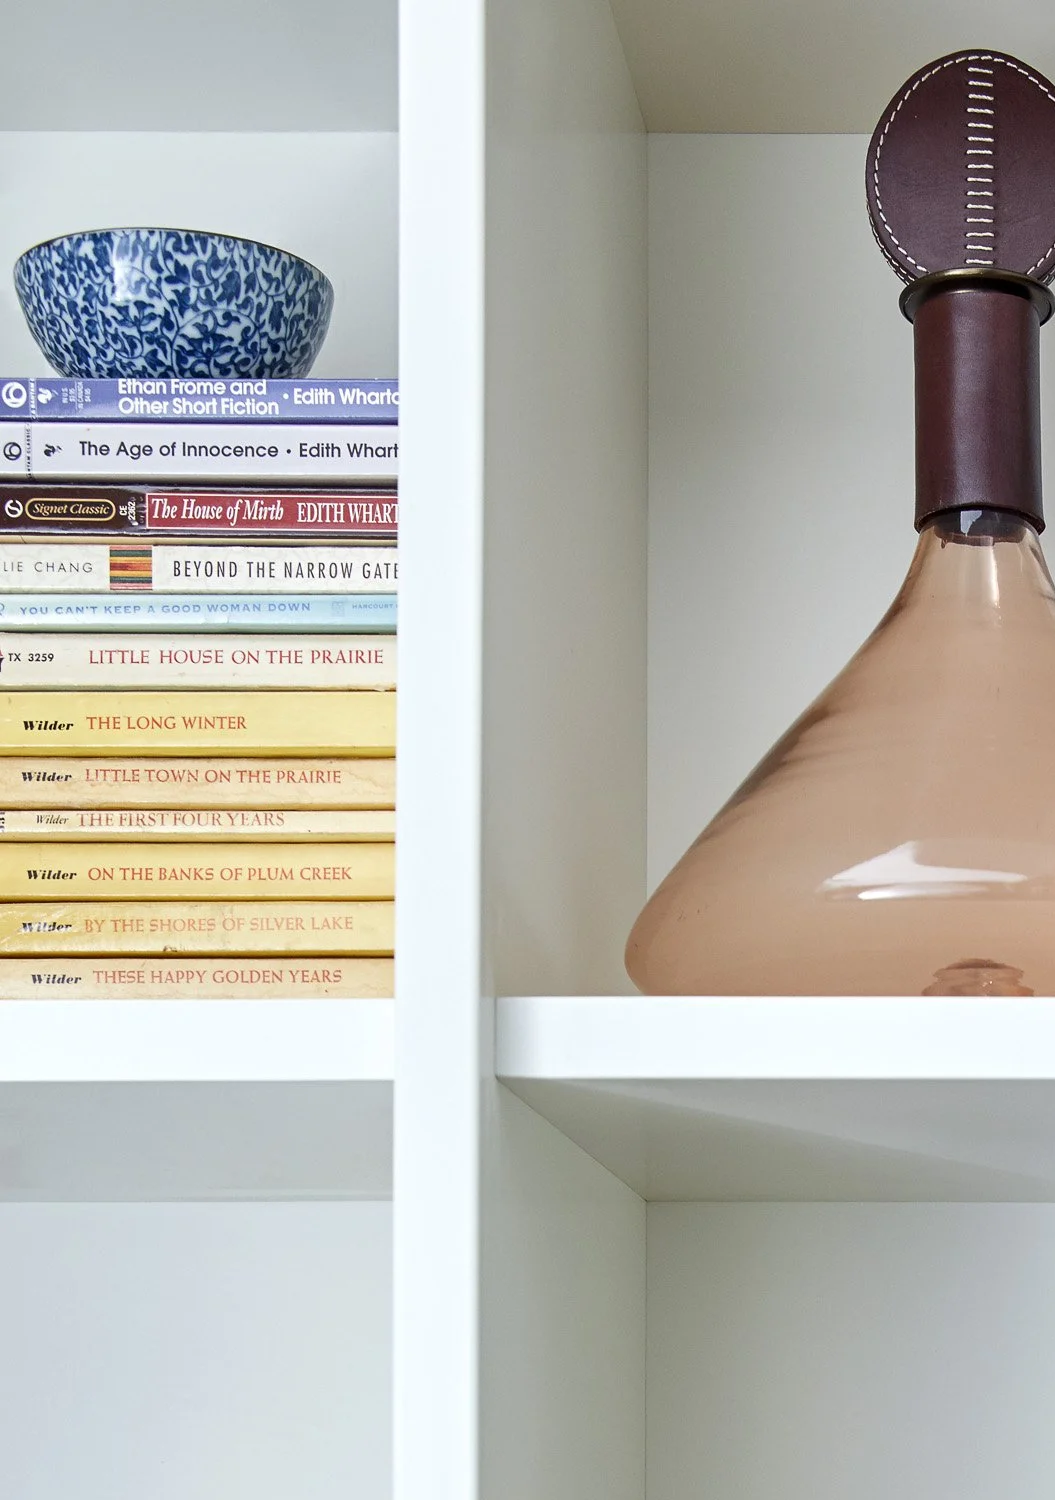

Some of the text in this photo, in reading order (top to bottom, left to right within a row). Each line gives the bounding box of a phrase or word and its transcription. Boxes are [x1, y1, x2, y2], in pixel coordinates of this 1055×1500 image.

[118, 379, 267, 395] Ethan Frome and
[293, 388, 336, 405] Edith
[118, 397, 279, 415] Other Short Fiction
[79, 441, 399, 461] The Age of Innocence Edith Whart
[32, 503, 110, 516] Signet Classic
[119, 505, 128, 516] CE
[127, 501, 136, 520] 2362
[151, 498, 178, 521] The
[180, 499, 223, 521] House
[225, 499, 243, 526] of
[243, 499, 284, 521] Mirth
[297, 502, 345, 523] EDITH
[34, 561, 93, 573] CHANG
[173, 561, 237, 578] BEYOND
[246, 562, 275, 578] THE
[284, 562, 353, 579] NARROW
[20, 602, 311, 615] YOU CAN'T KEEP A GOOD WOMAN DOWN
[8, 652, 54, 662] TX 3259
[89, 650, 384, 665] LITTLE HOUSE ON THE PRAIRIE
[23, 716, 247, 732] Wilder THE LONG WINTER
[21, 769, 342, 784] Wilder LITTLE TOWN ON THE PRAIRIE
[36, 812, 285, 827] Wilder THE FIRST FOUR YEARS
[27, 866, 353, 881] Wilder ON THE BANKS OF PLUM CREEK
[85, 917, 354, 933] BY THE SHORES OF SILVER LAKE
[31, 970, 343, 986] Wilder THESE HAPPY GOLDEN YEARS
